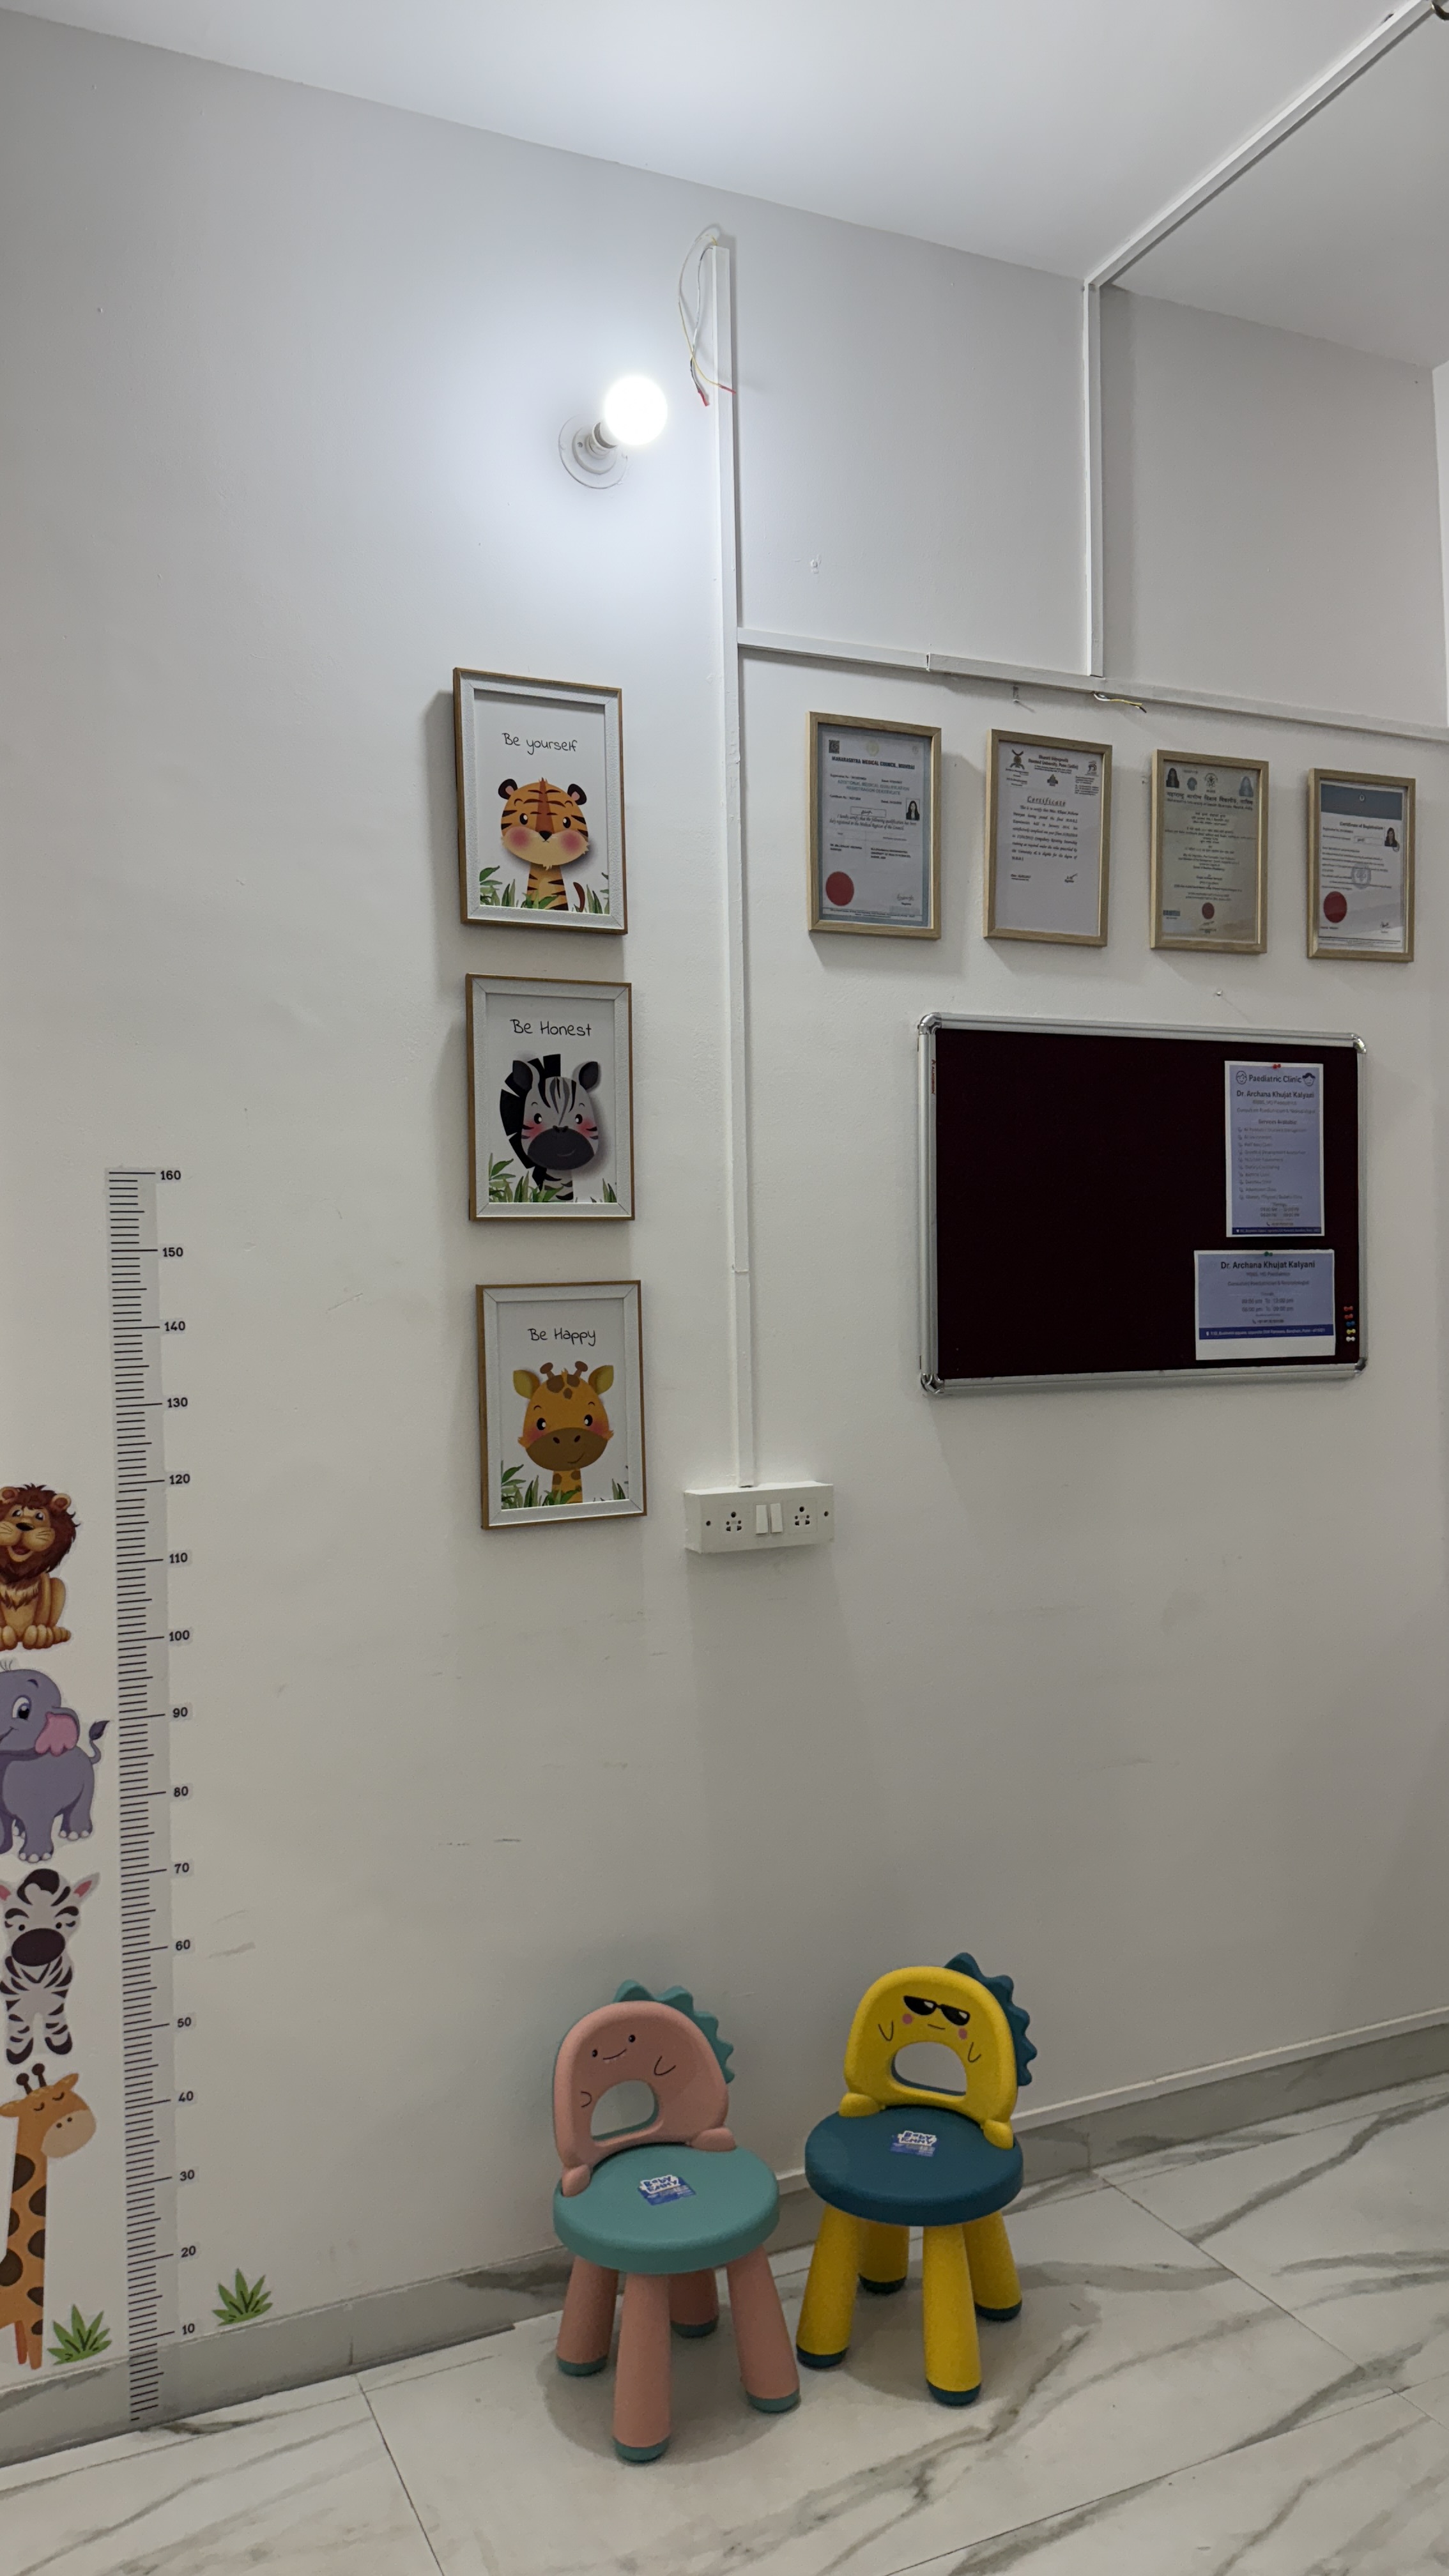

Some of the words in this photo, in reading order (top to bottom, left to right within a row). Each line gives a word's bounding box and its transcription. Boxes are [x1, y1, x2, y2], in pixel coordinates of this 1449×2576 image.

[502, 733, 520, 746] Be
[526, 740, 577, 755] yourself
[1027, 796, 1066, 806] Certificate
[510, 1019, 533, 1034] Be
[540, 1021, 592, 1036] Honest
[1249, 1075, 1282, 1083] Paediatric
[1273, 1091, 1292, 1099] Khujat
[1293, 1091, 1314, 1099] Kalyani
[160, 1170, 181, 1180] 160
[162, 1247, 183, 1257] 150
[1221, 1261, 1230, 1269] Dr.
[1264, 1261, 1287, 1270] Khujat
[1289, 1260, 1315, 1269] Kalyani
[164, 1321, 185, 1331] 140
[528, 1328, 548, 1340] Be
[555, 1328, 595, 1346] Happy
[167, 1397, 188, 1408] 130
[169, 1473, 190, 1485] 120
[169, 1552, 188, 1563] 110
[169, 1630, 190, 1641] 100
[172, 1707, 188, 1718] 90
[174, 1786, 188, 1797] 80
[174, 1862, 189, 1874] 70
[176, 1940, 190, 1951] 60
[178, 2017, 192, 2028] 50
[178, 2090, 194, 2102] 40
[180, 2170, 195, 2181] 30
[181, 2246, 196, 2258] 20
[183, 2323, 195, 2335] 10
